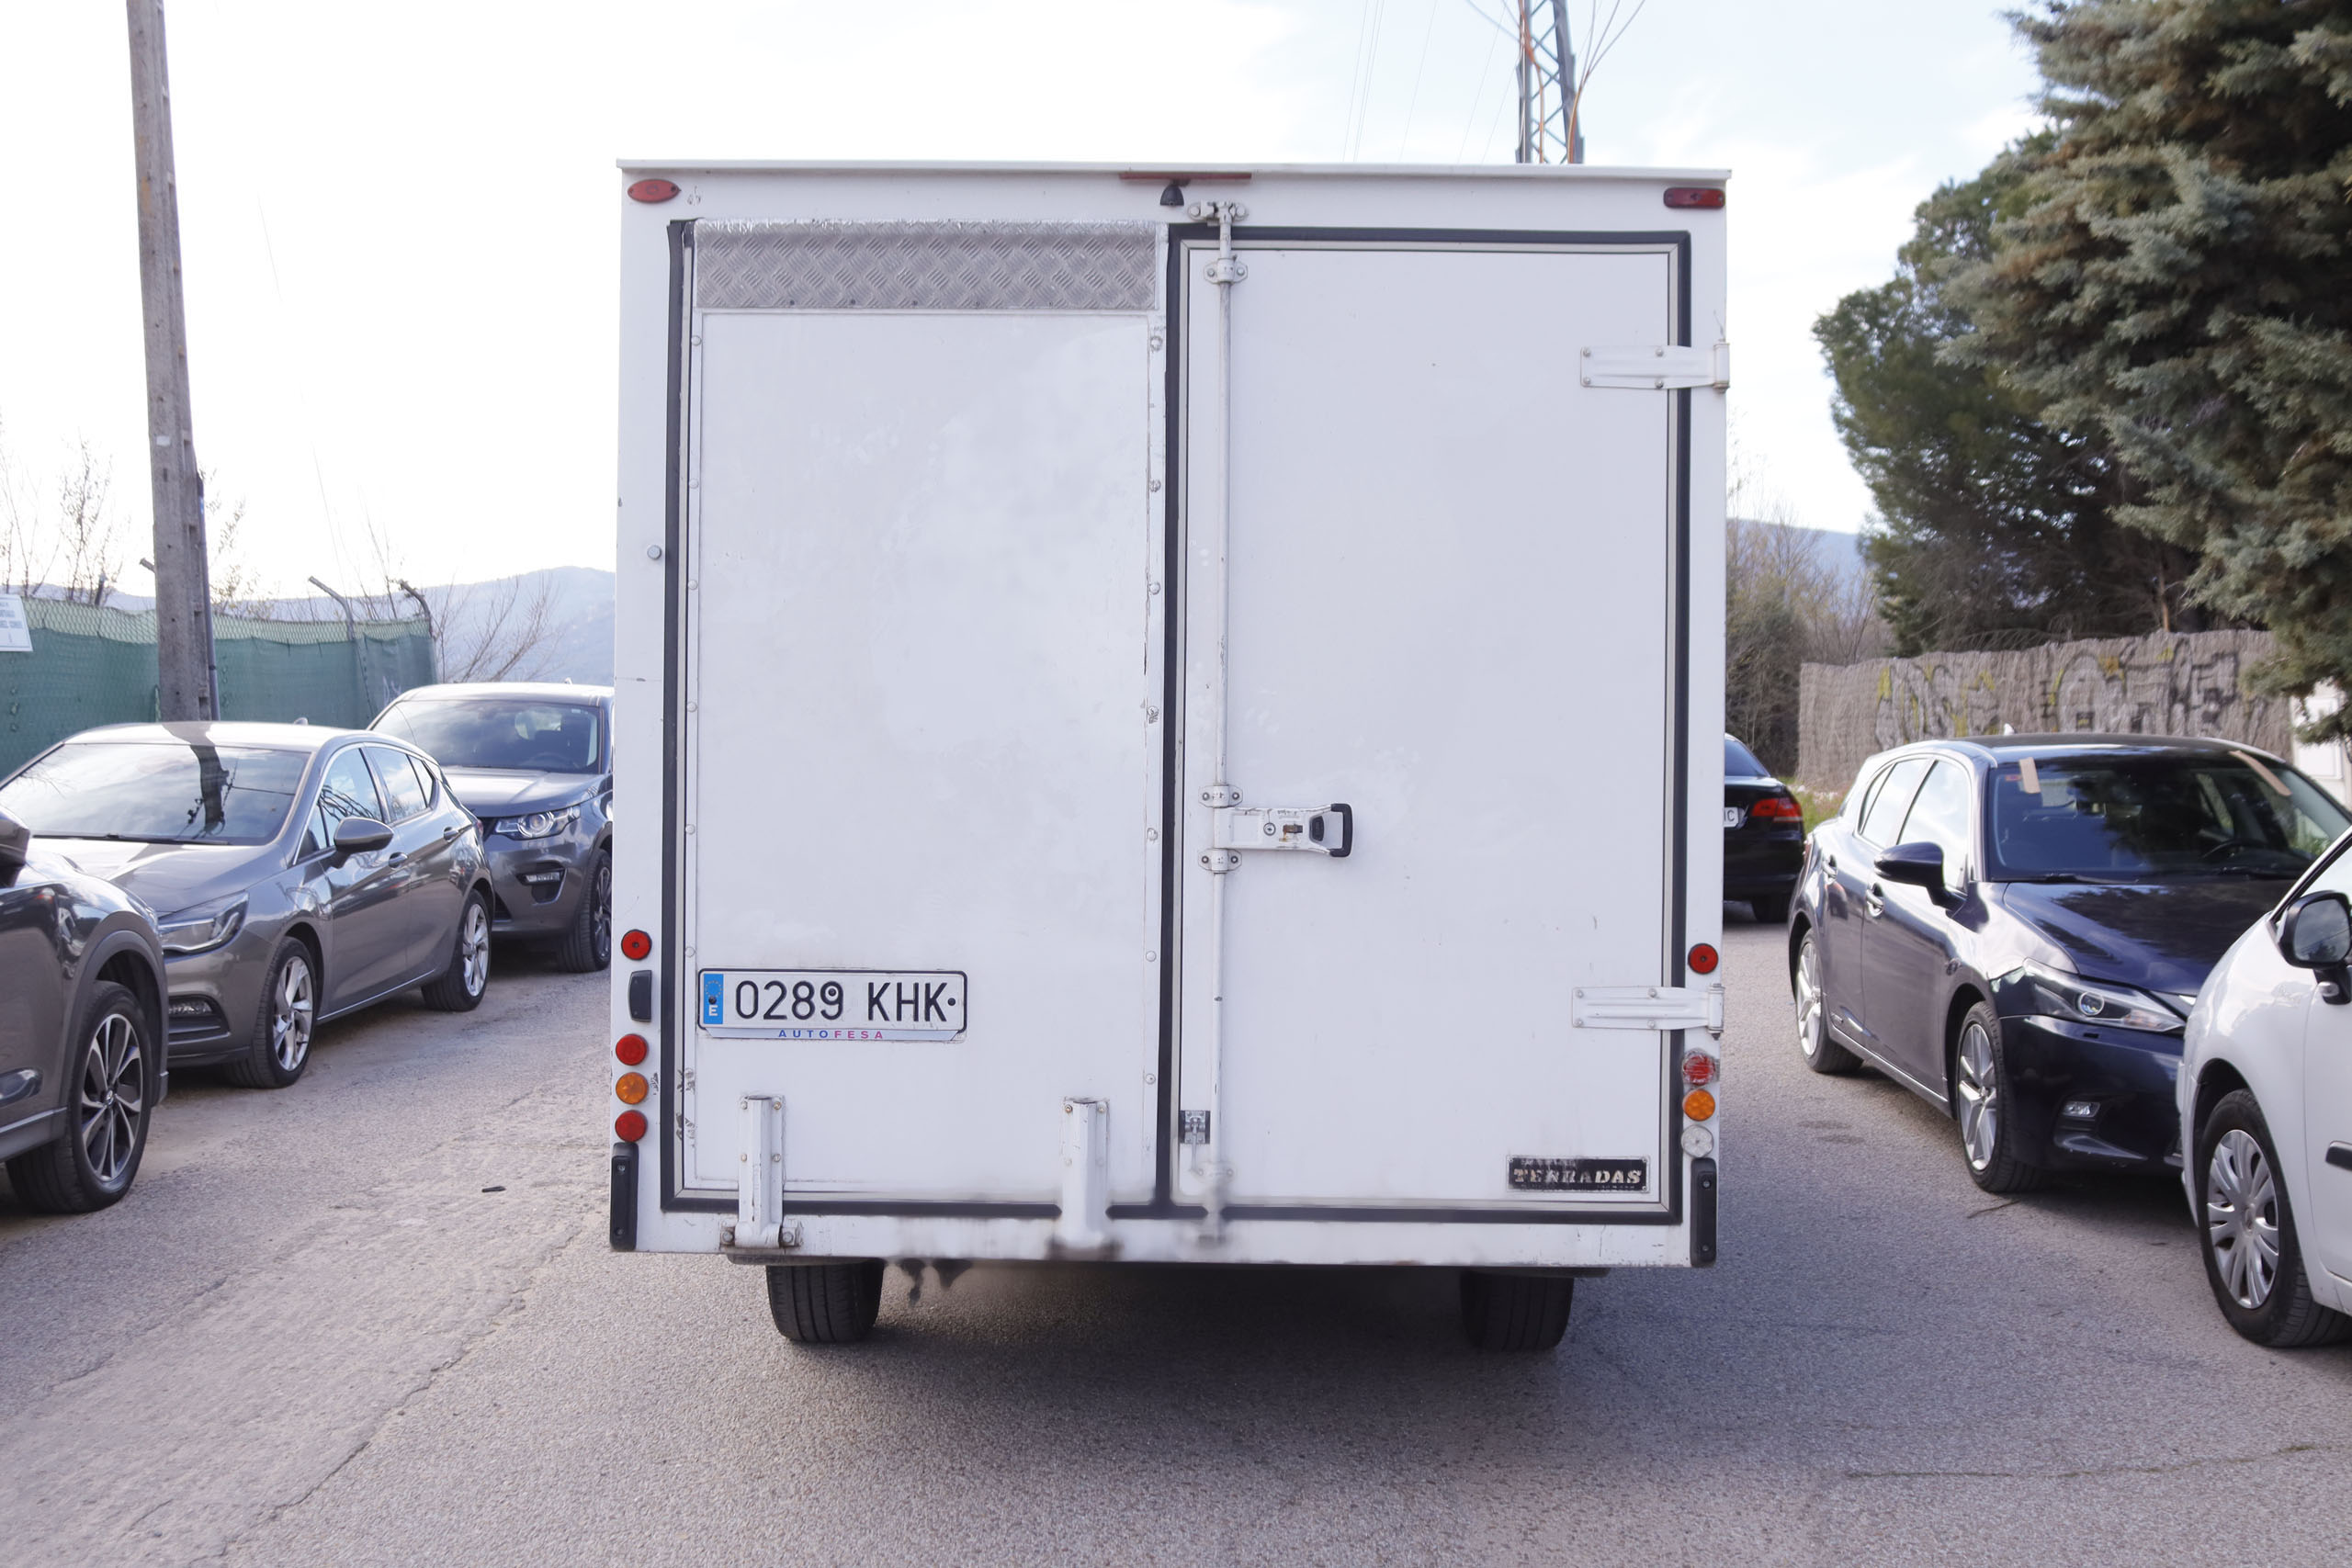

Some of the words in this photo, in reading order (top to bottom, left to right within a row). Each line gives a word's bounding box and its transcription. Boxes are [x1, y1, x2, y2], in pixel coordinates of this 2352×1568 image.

[708, 1004, 718, 1017] E
[735, 979, 844, 1021] 0289
[867, 981, 948, 1022] KHK
